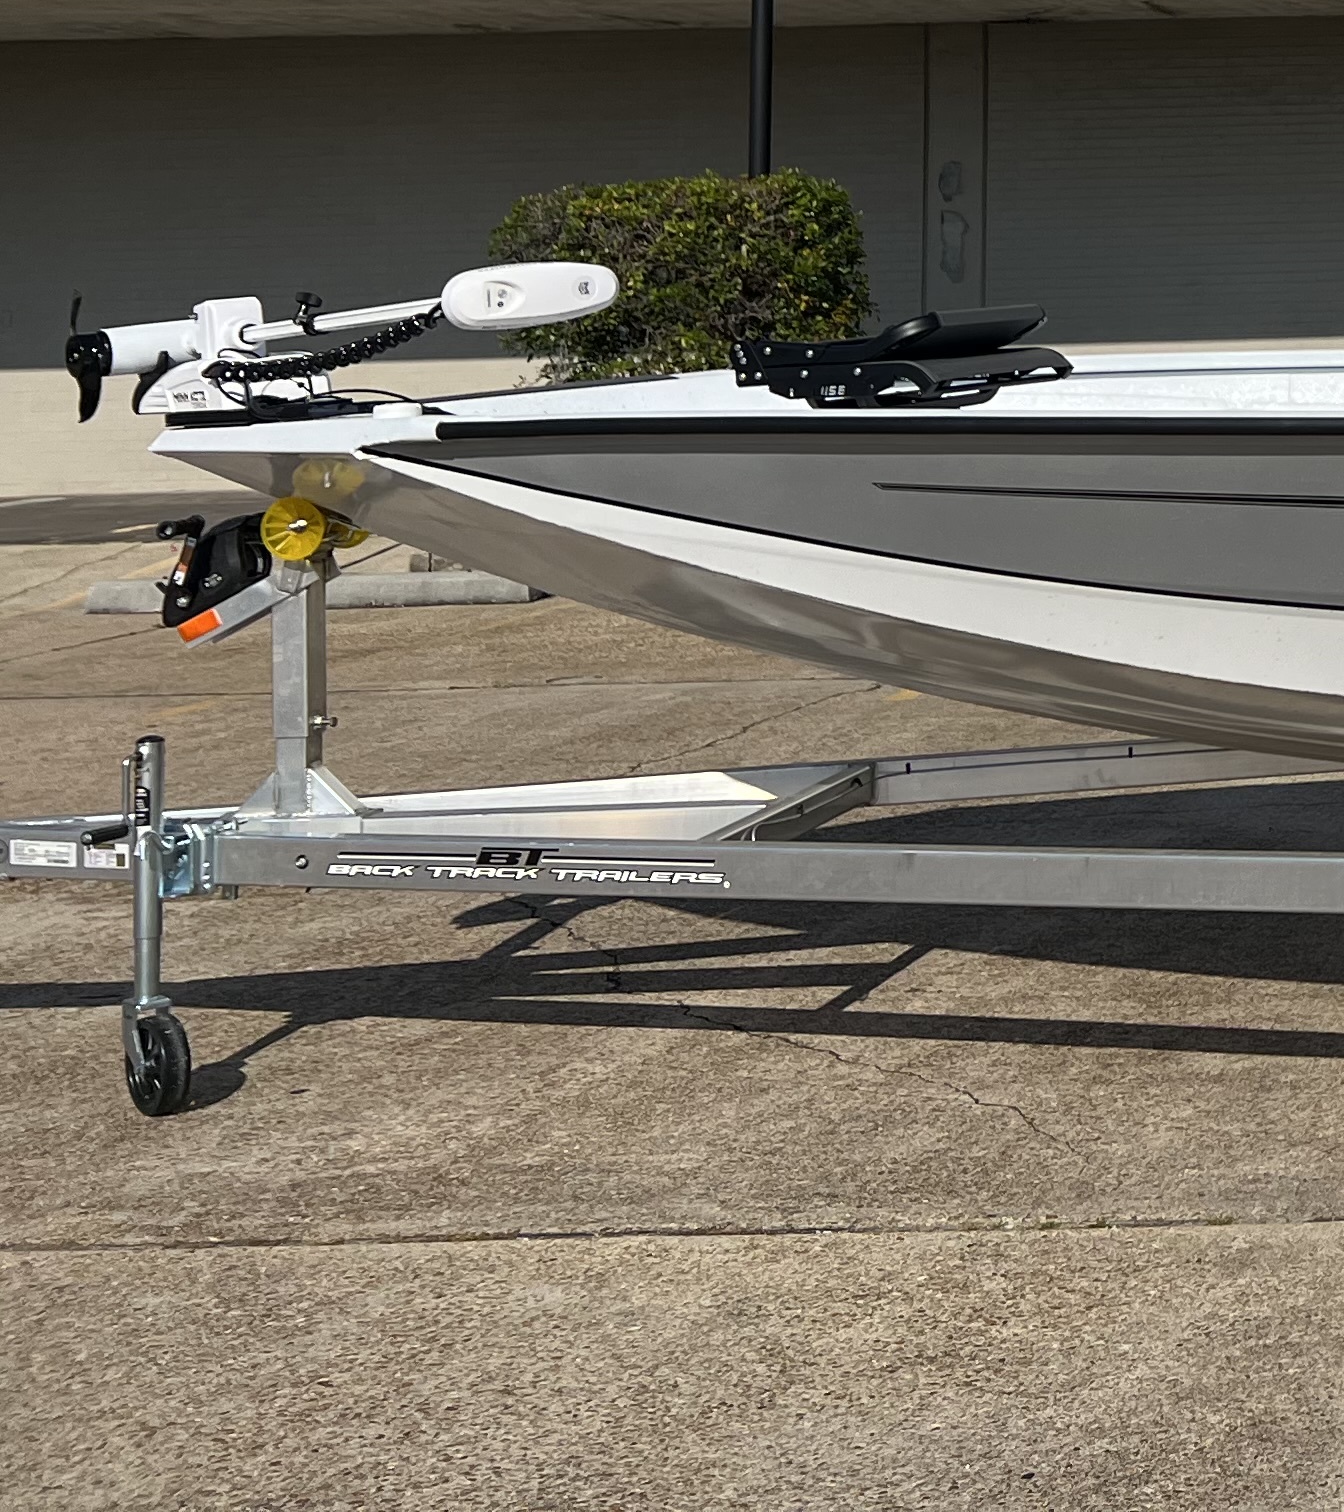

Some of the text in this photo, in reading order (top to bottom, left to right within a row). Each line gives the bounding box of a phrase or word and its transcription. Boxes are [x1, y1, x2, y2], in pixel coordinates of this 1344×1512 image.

[475, 847, 560, 866] BT
[326, 864, 727, 885] BACK TRACK TRAILERS
